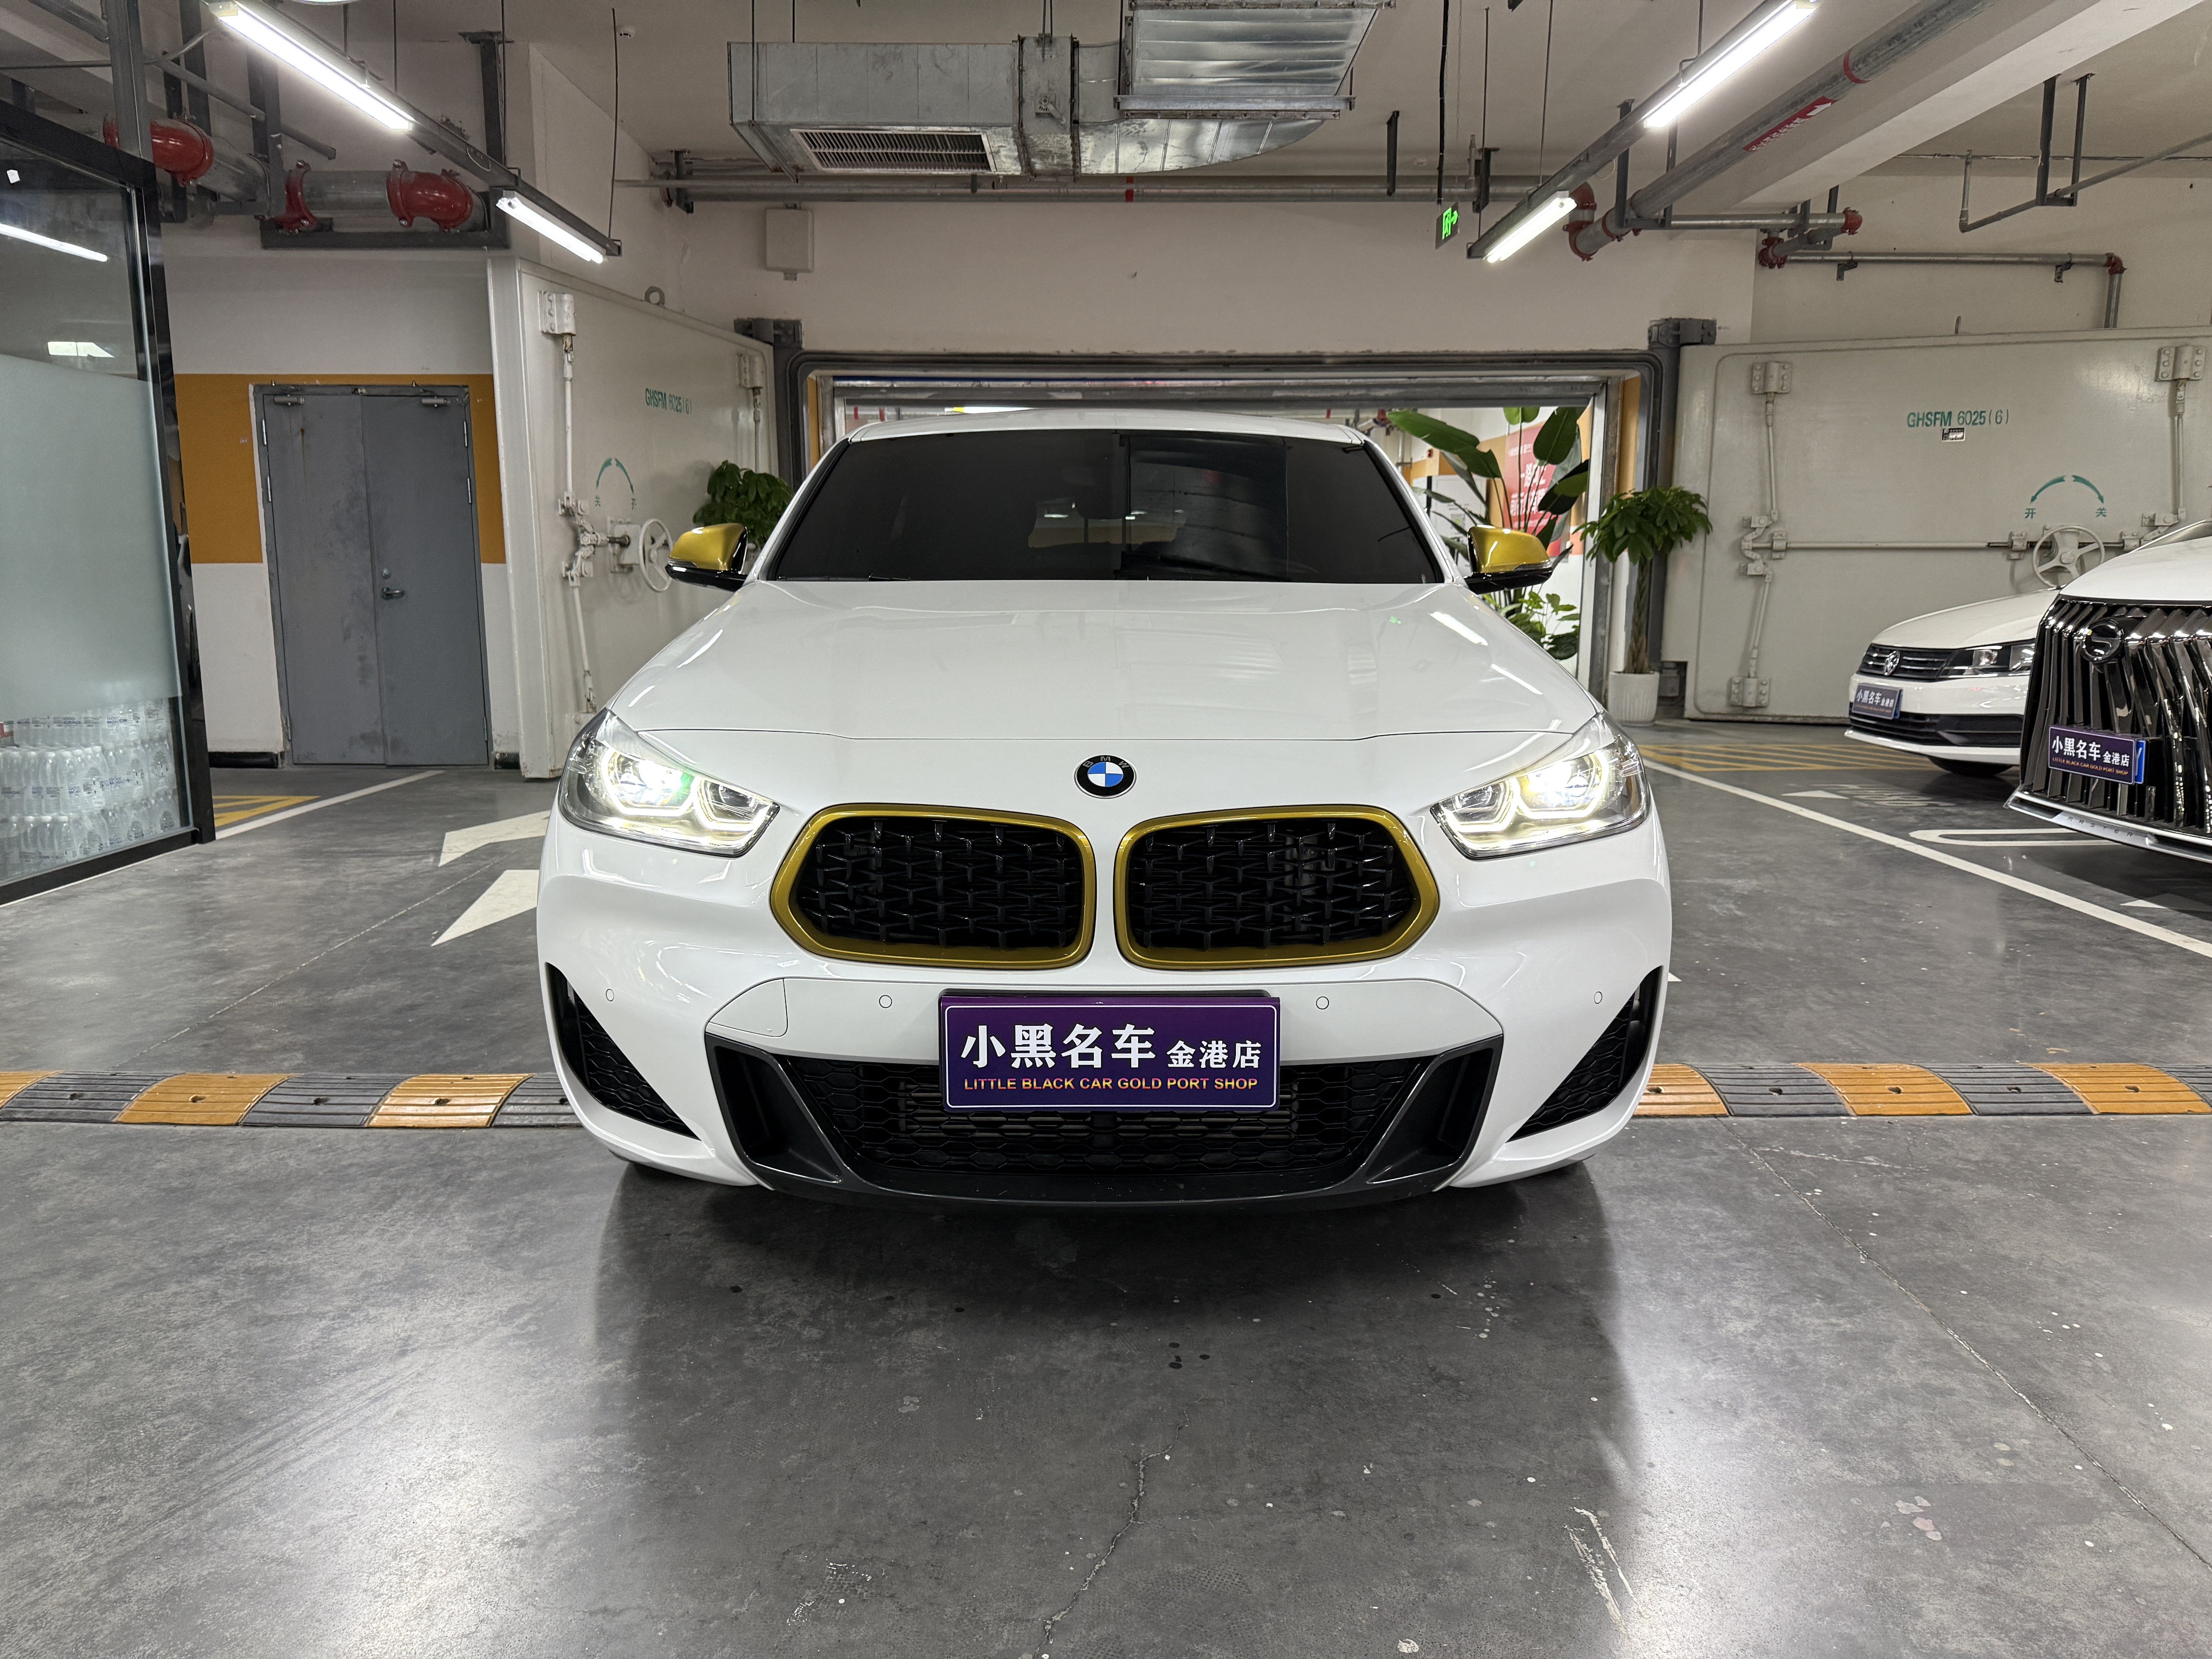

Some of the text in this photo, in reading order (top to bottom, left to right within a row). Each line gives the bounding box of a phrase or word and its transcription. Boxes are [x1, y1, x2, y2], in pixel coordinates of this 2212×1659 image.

[645, 388, 667, 410] GHSFM
[1907, 409, 2009, 428] GHSFM 6025(6)
[2025, 508, 2036, 519] 开
[2095, 507, 2107, 517] 关
[1856, 689, 1882, 705] 小黑名车
[2052, 735, 2101, 761] 小黑名车
[2102, 750, 2130, 767] 金港店
[1082, 756, 1130, 768] BMW
[2067, 816, 2134, 837] MASTER
[961, 1023, 1261, 1068] 小黑名车 金港店
[964, 1078, 1258, 1090] LITTLE BLACK CAR GOLD PORT SHOP
